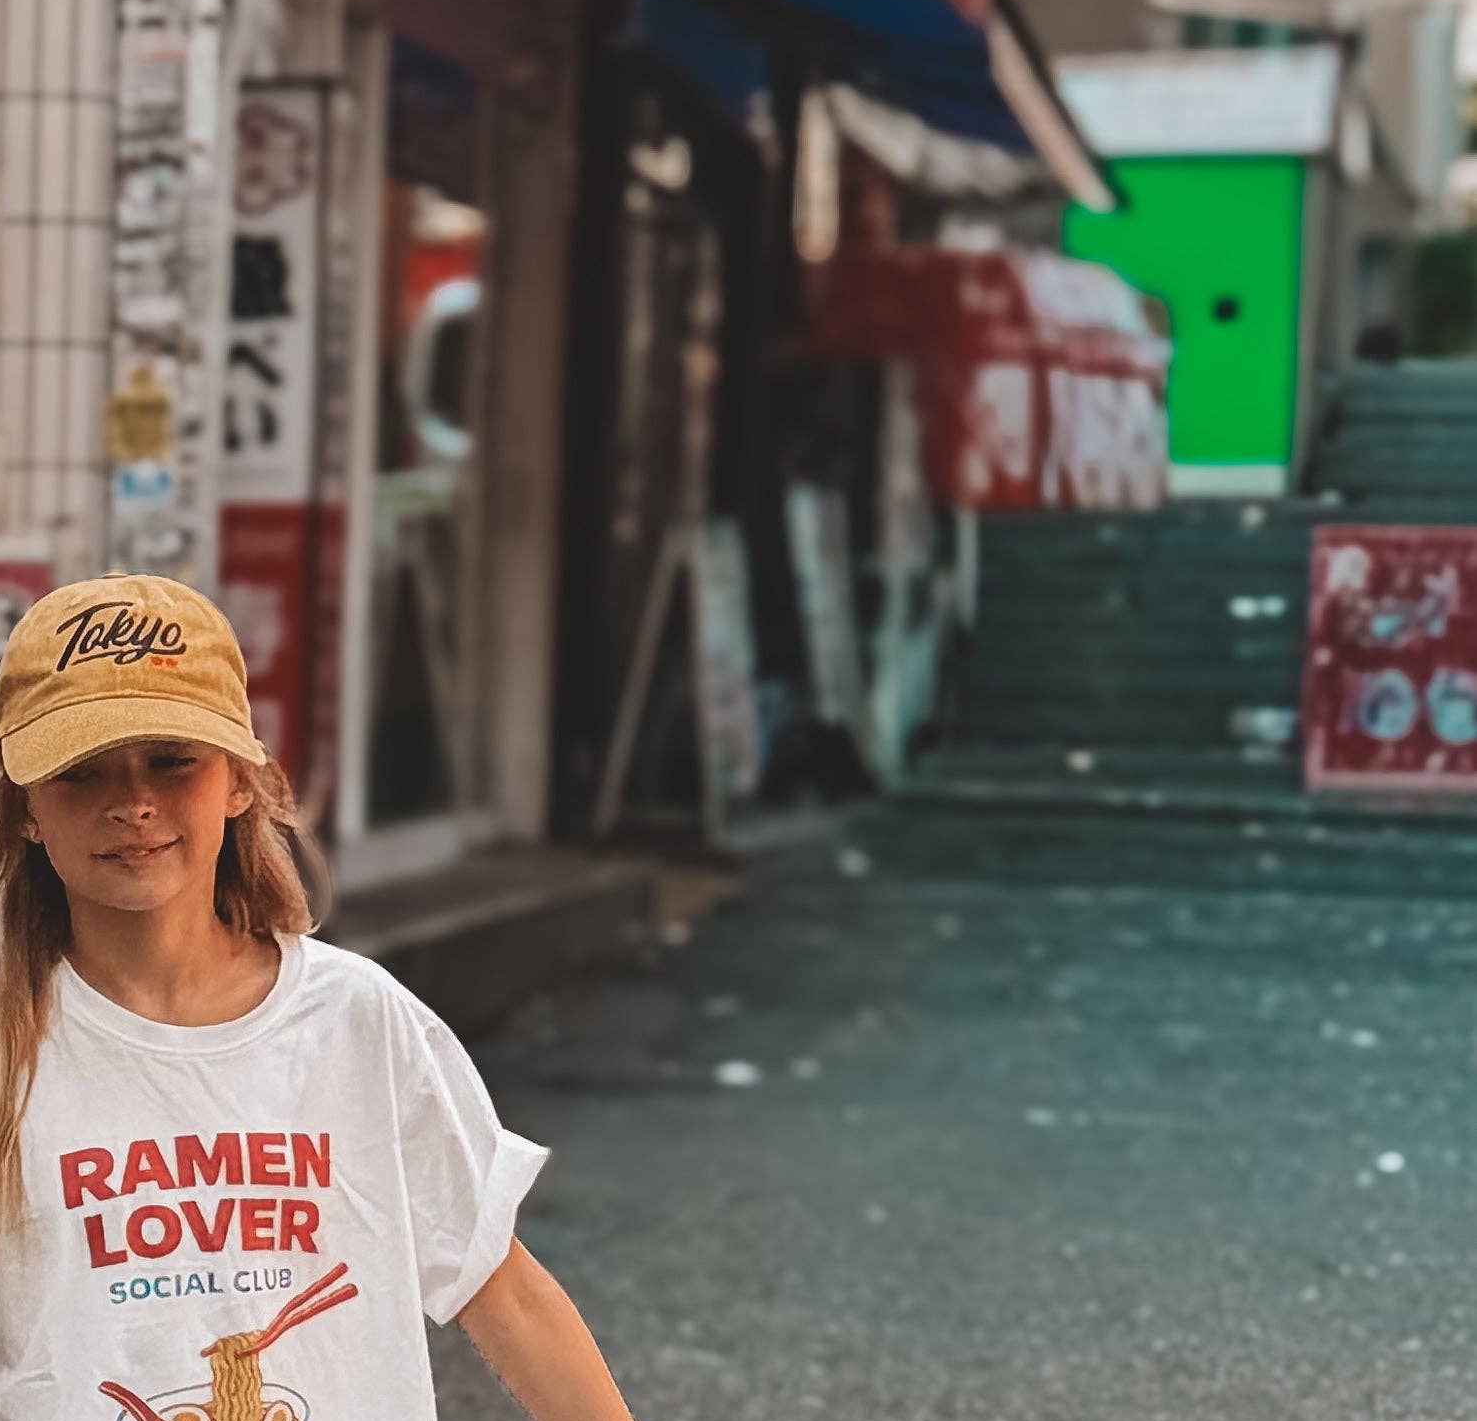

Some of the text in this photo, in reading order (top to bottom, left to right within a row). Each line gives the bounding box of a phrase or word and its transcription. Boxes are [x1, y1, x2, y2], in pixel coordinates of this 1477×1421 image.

[56, 601, 186, 671] Tokyo
[59, 1132, 331, 1210] RAMEN
[84, 1198, 320, 1268] LOVER
[109, 1268, 293, 1304] SOCIAL CLUB
